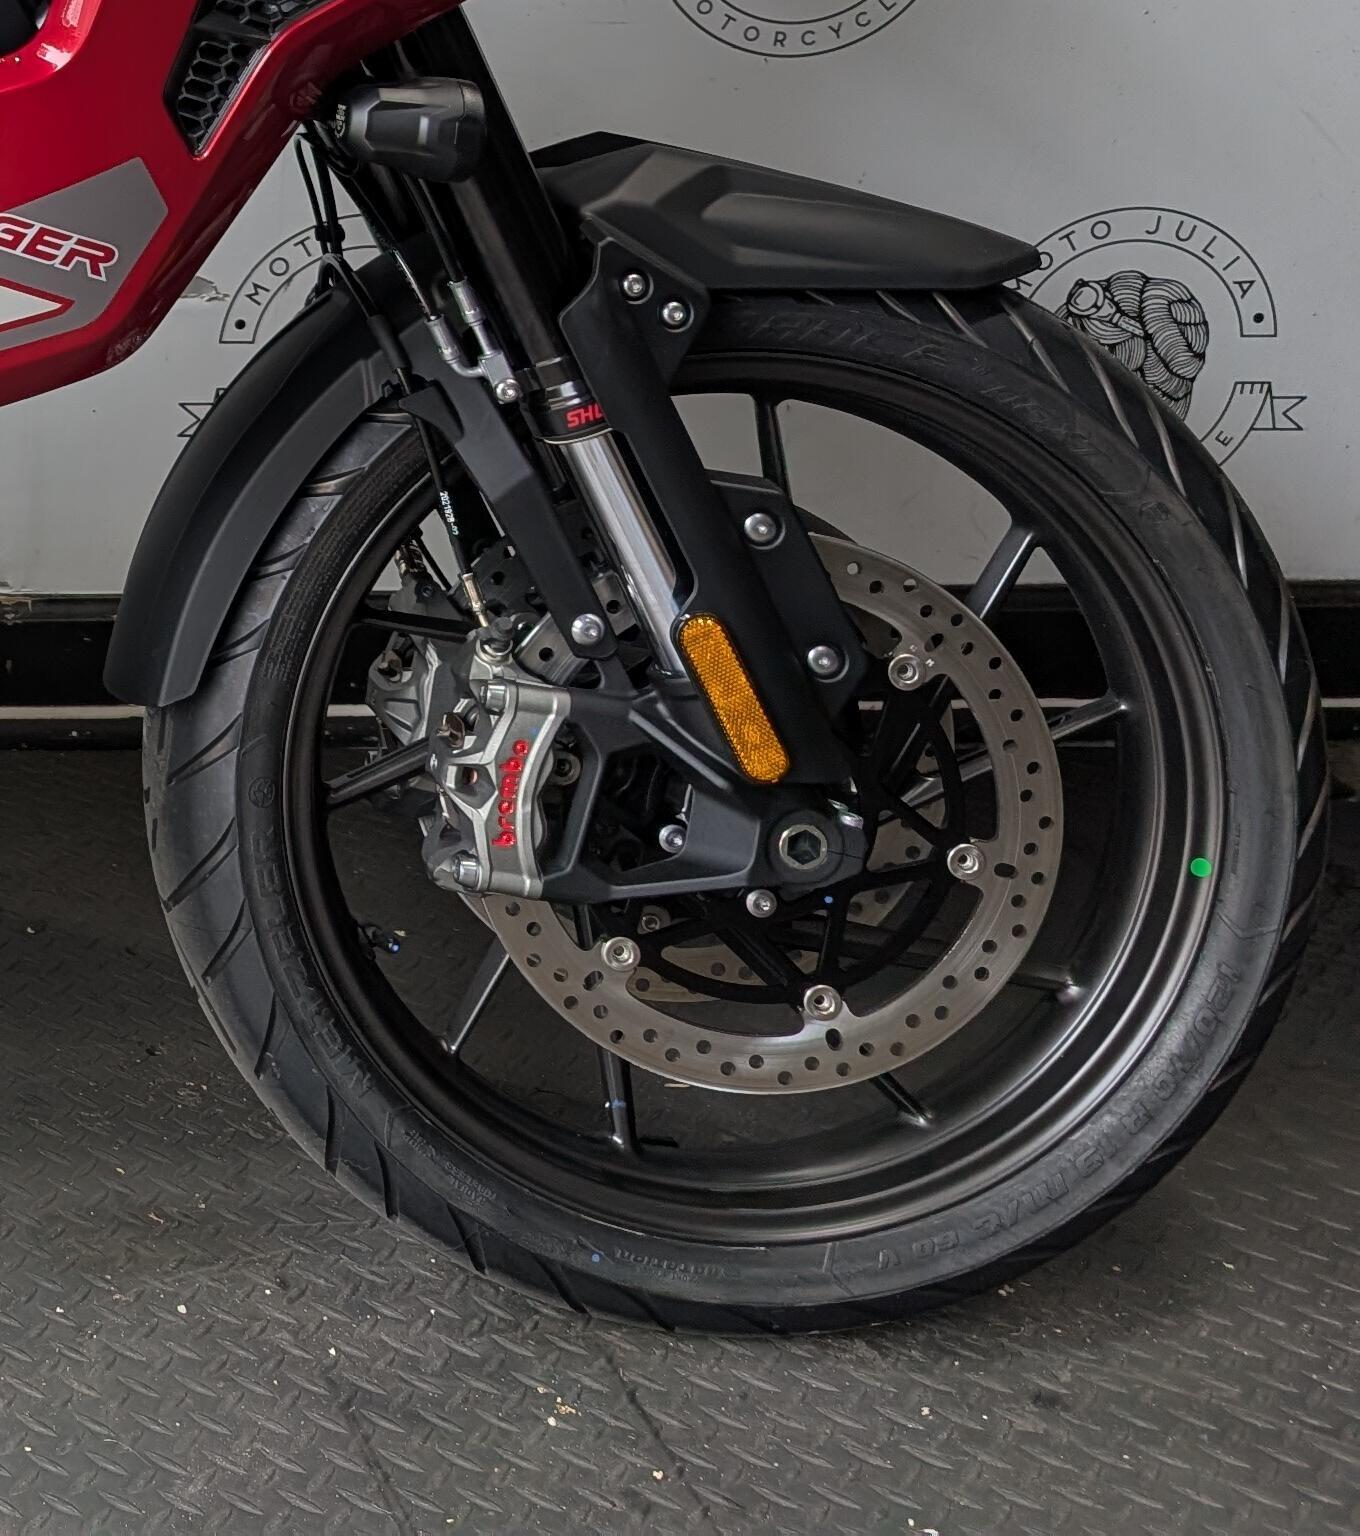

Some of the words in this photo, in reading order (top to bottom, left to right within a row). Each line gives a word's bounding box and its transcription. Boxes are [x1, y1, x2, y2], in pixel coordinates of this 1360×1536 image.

[243, 236, 317, 306] MOT
[1145, 215, 1256, 299] JULIA
[492, 739, 530, 848] brembo
